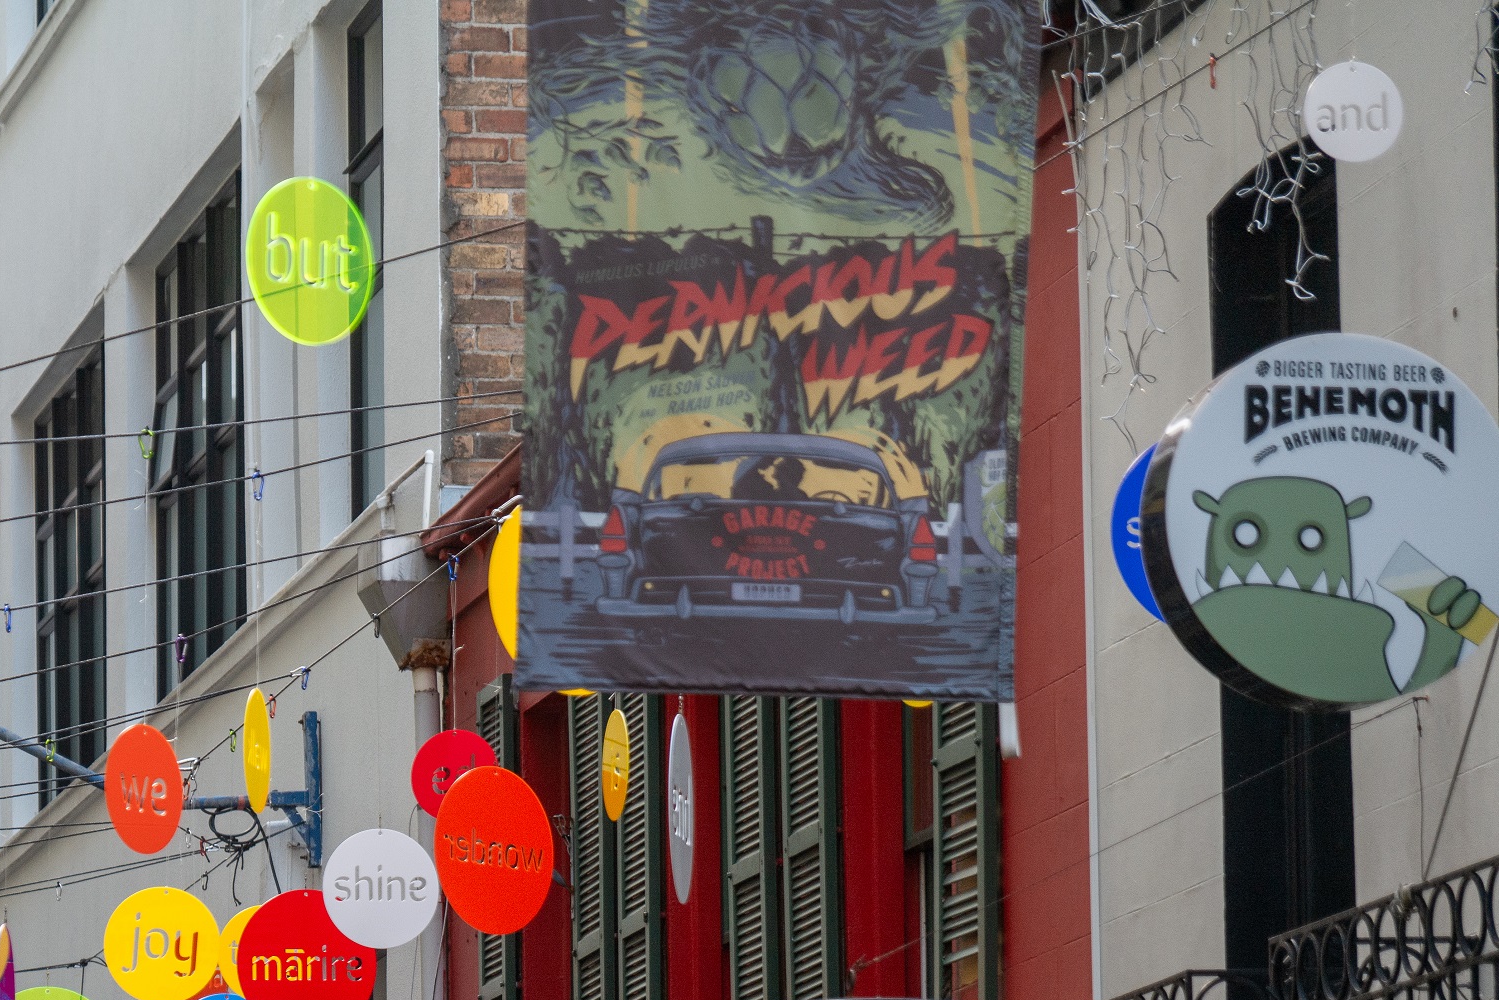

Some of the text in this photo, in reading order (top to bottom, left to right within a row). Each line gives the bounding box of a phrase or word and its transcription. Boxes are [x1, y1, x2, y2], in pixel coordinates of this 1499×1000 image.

[1317, 90, 1389, 133] and
[266, 211, 358, 294] but
[570, 229, 961, 403] PERNICIOUS
[802, 314, 993, 431] WEED
[1274, 360, 1427, 383] BIGGER TASTING BEER
[1244, 384, 1456, 454] BEHEMOTH
[1282, 426, 1419, 456] BREWING COMPANY
[723, 505, 817, 536] GARAGE
[725, 551, 810, 580] PROJECT
[119, 772, 167, 816] we
[334, 864, 427, 902] shine
[122, 911, 199, 978] joy
[251, 944, 363, 982] mārire
